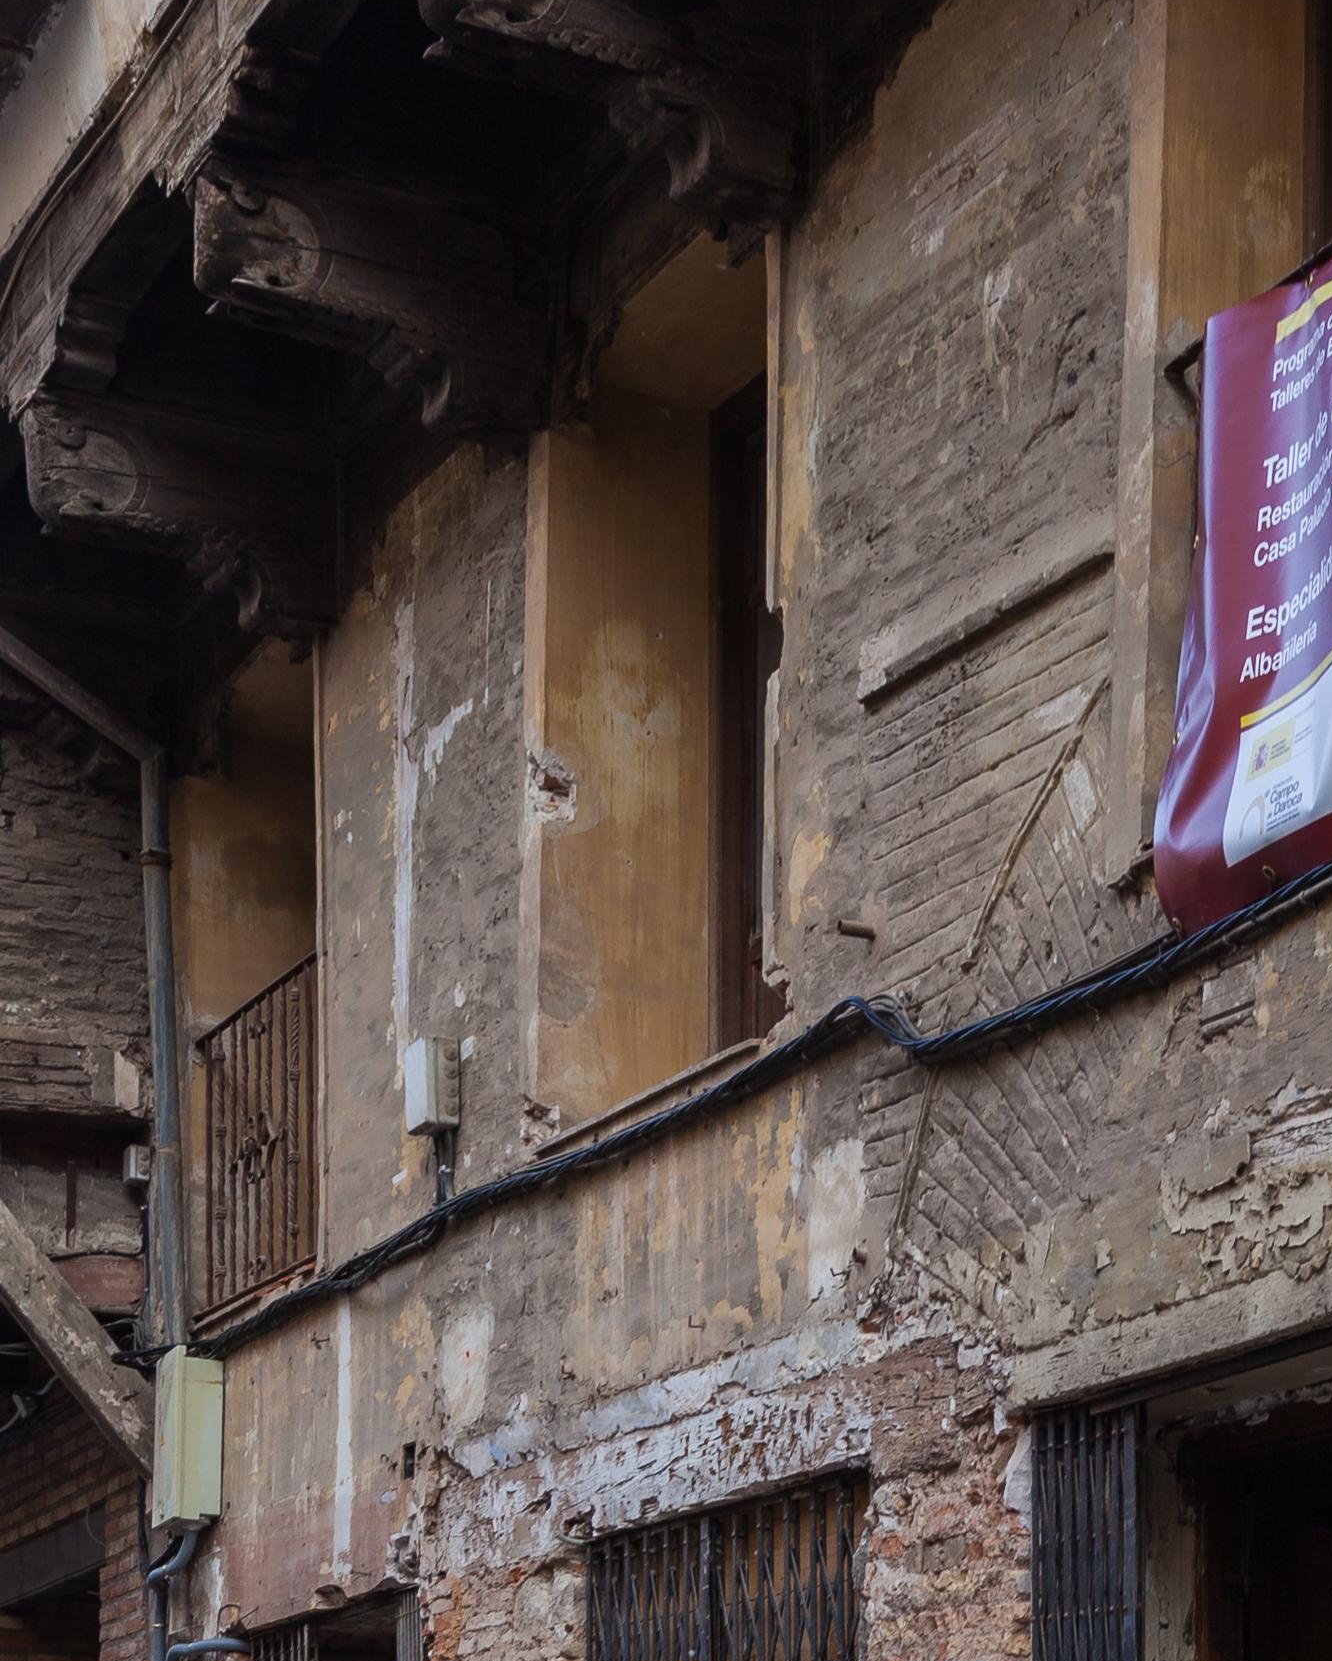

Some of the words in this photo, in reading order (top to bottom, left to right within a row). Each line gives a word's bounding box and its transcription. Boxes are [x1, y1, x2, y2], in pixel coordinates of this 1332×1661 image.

[1270, 369, 1315, 412] Talleres
[1315, 351, 1325, 373] de
[1273, 323, 1324, 382] Programa
[1263, 432, 1315, 488] Taller
[1315, 411, 1328, 449] de
[1253, 531, 1296, 568] Casa
[1300, 487, 1332, 544] Palacio
[1240, 620, 1318, 683] Albañilería
[1269, 780, 1299, 804] Campo
[1273, 792, 1302, 816] Daroca
